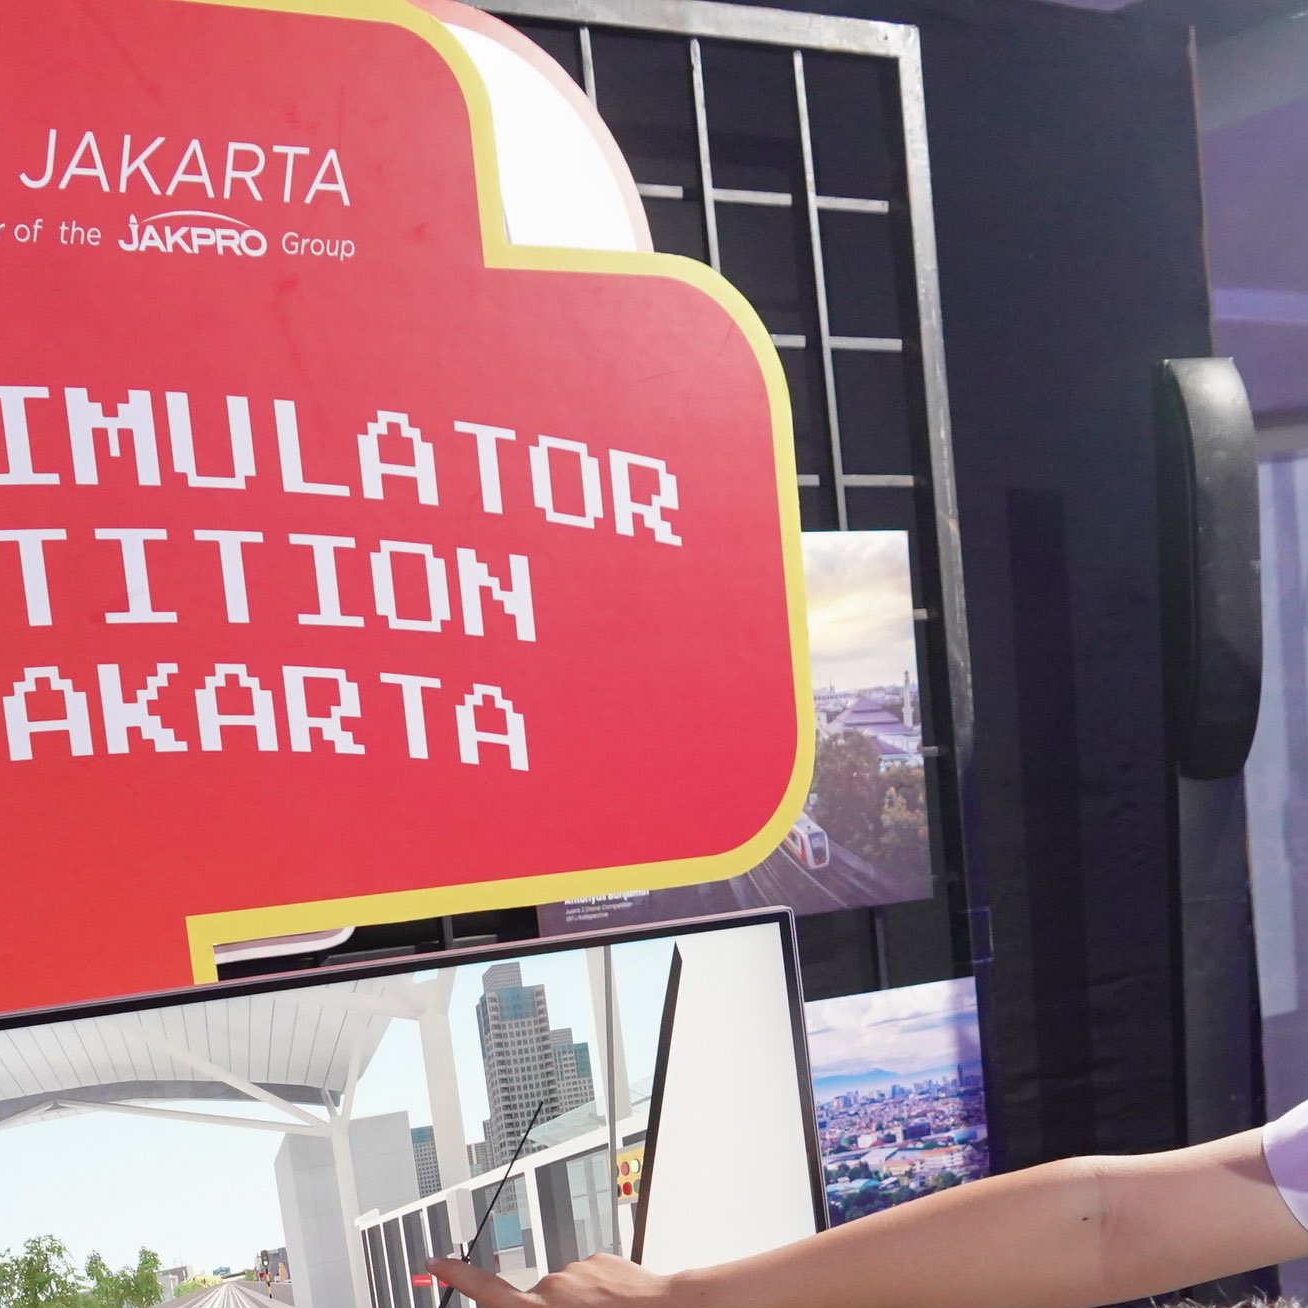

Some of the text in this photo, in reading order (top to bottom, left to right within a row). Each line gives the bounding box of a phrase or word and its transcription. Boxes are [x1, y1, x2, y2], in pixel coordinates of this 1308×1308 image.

[19, 128, 351, 206] JAKARTA
[13, 218, 42, 243] of
[59, 221, 102, 246] the
[118, 212, 267, 257] JAKPRO
[281, 232, 356, 261] Group
